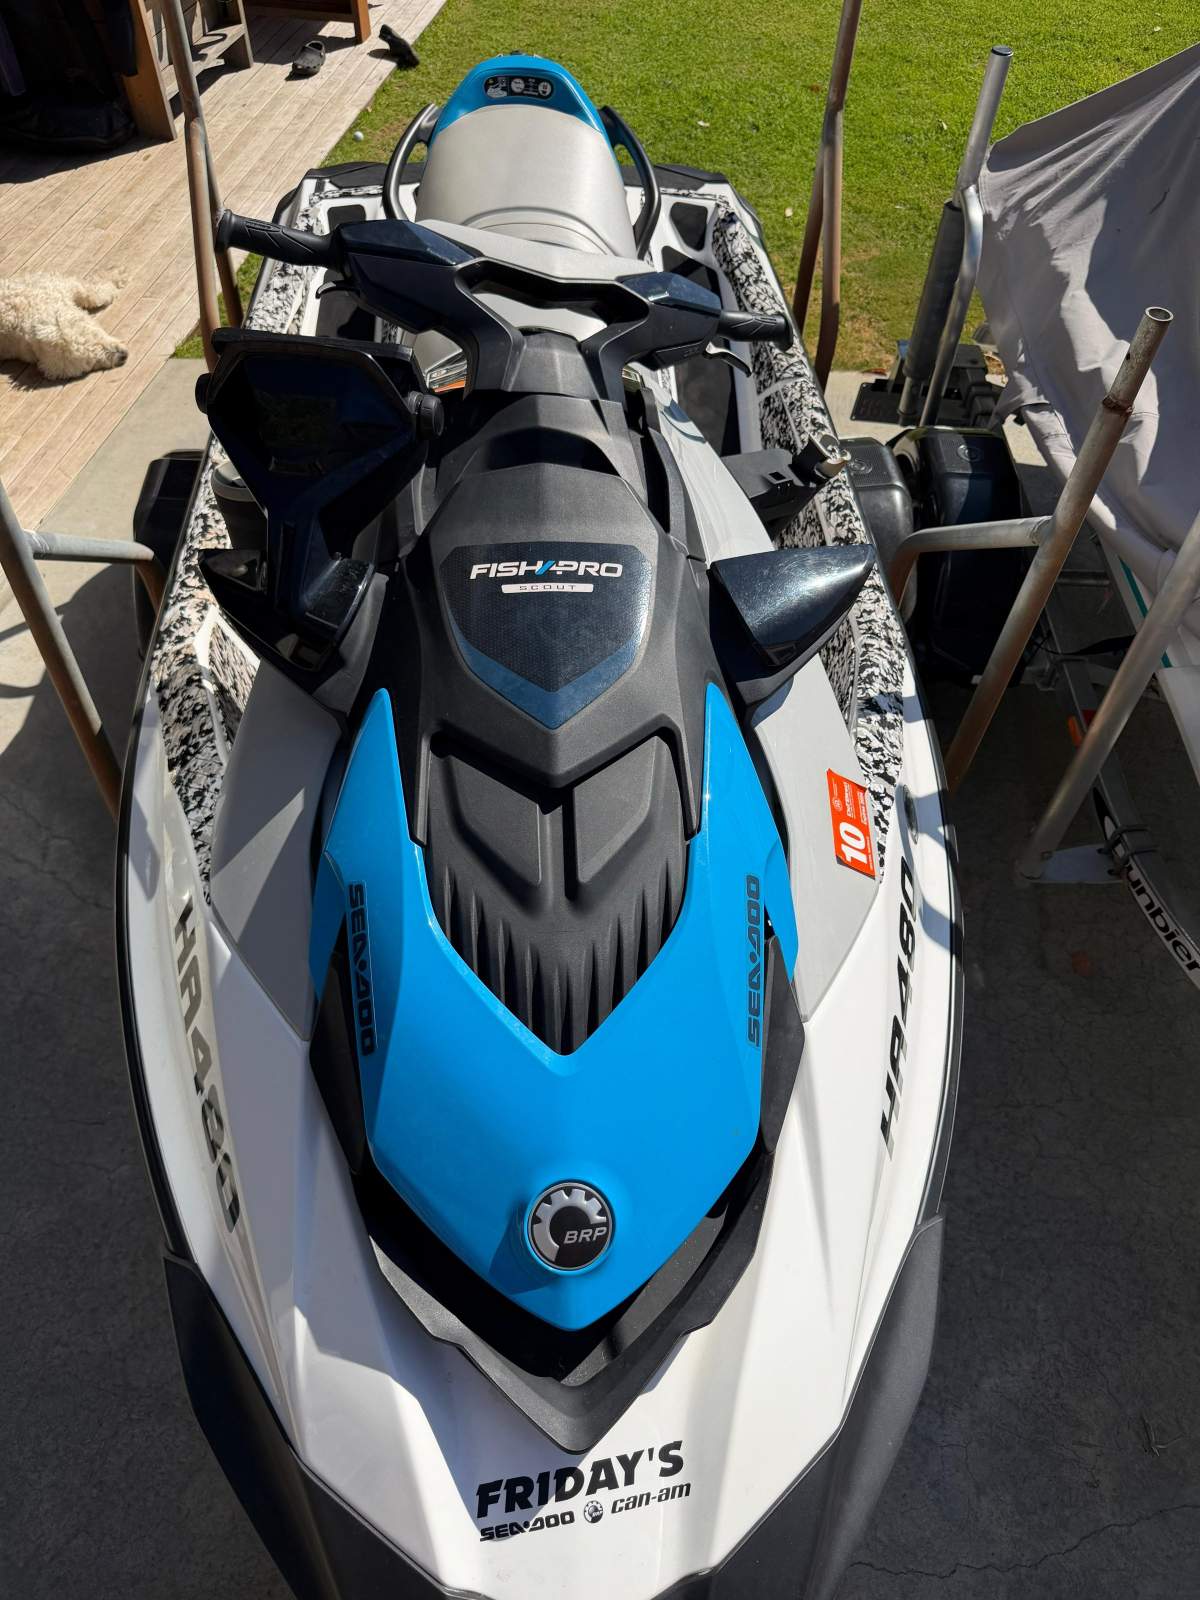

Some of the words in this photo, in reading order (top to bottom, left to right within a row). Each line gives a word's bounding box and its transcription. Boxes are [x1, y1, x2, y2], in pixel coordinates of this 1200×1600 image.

[839, 821, 868, 865] 10
[1125, 863, 1200, 972] unbier
[563, 1226, 607, 1245] BRP
[475, 1439, 684, 1519] FRIDAY'S
[610, 1482, 692, 1514] can-am
